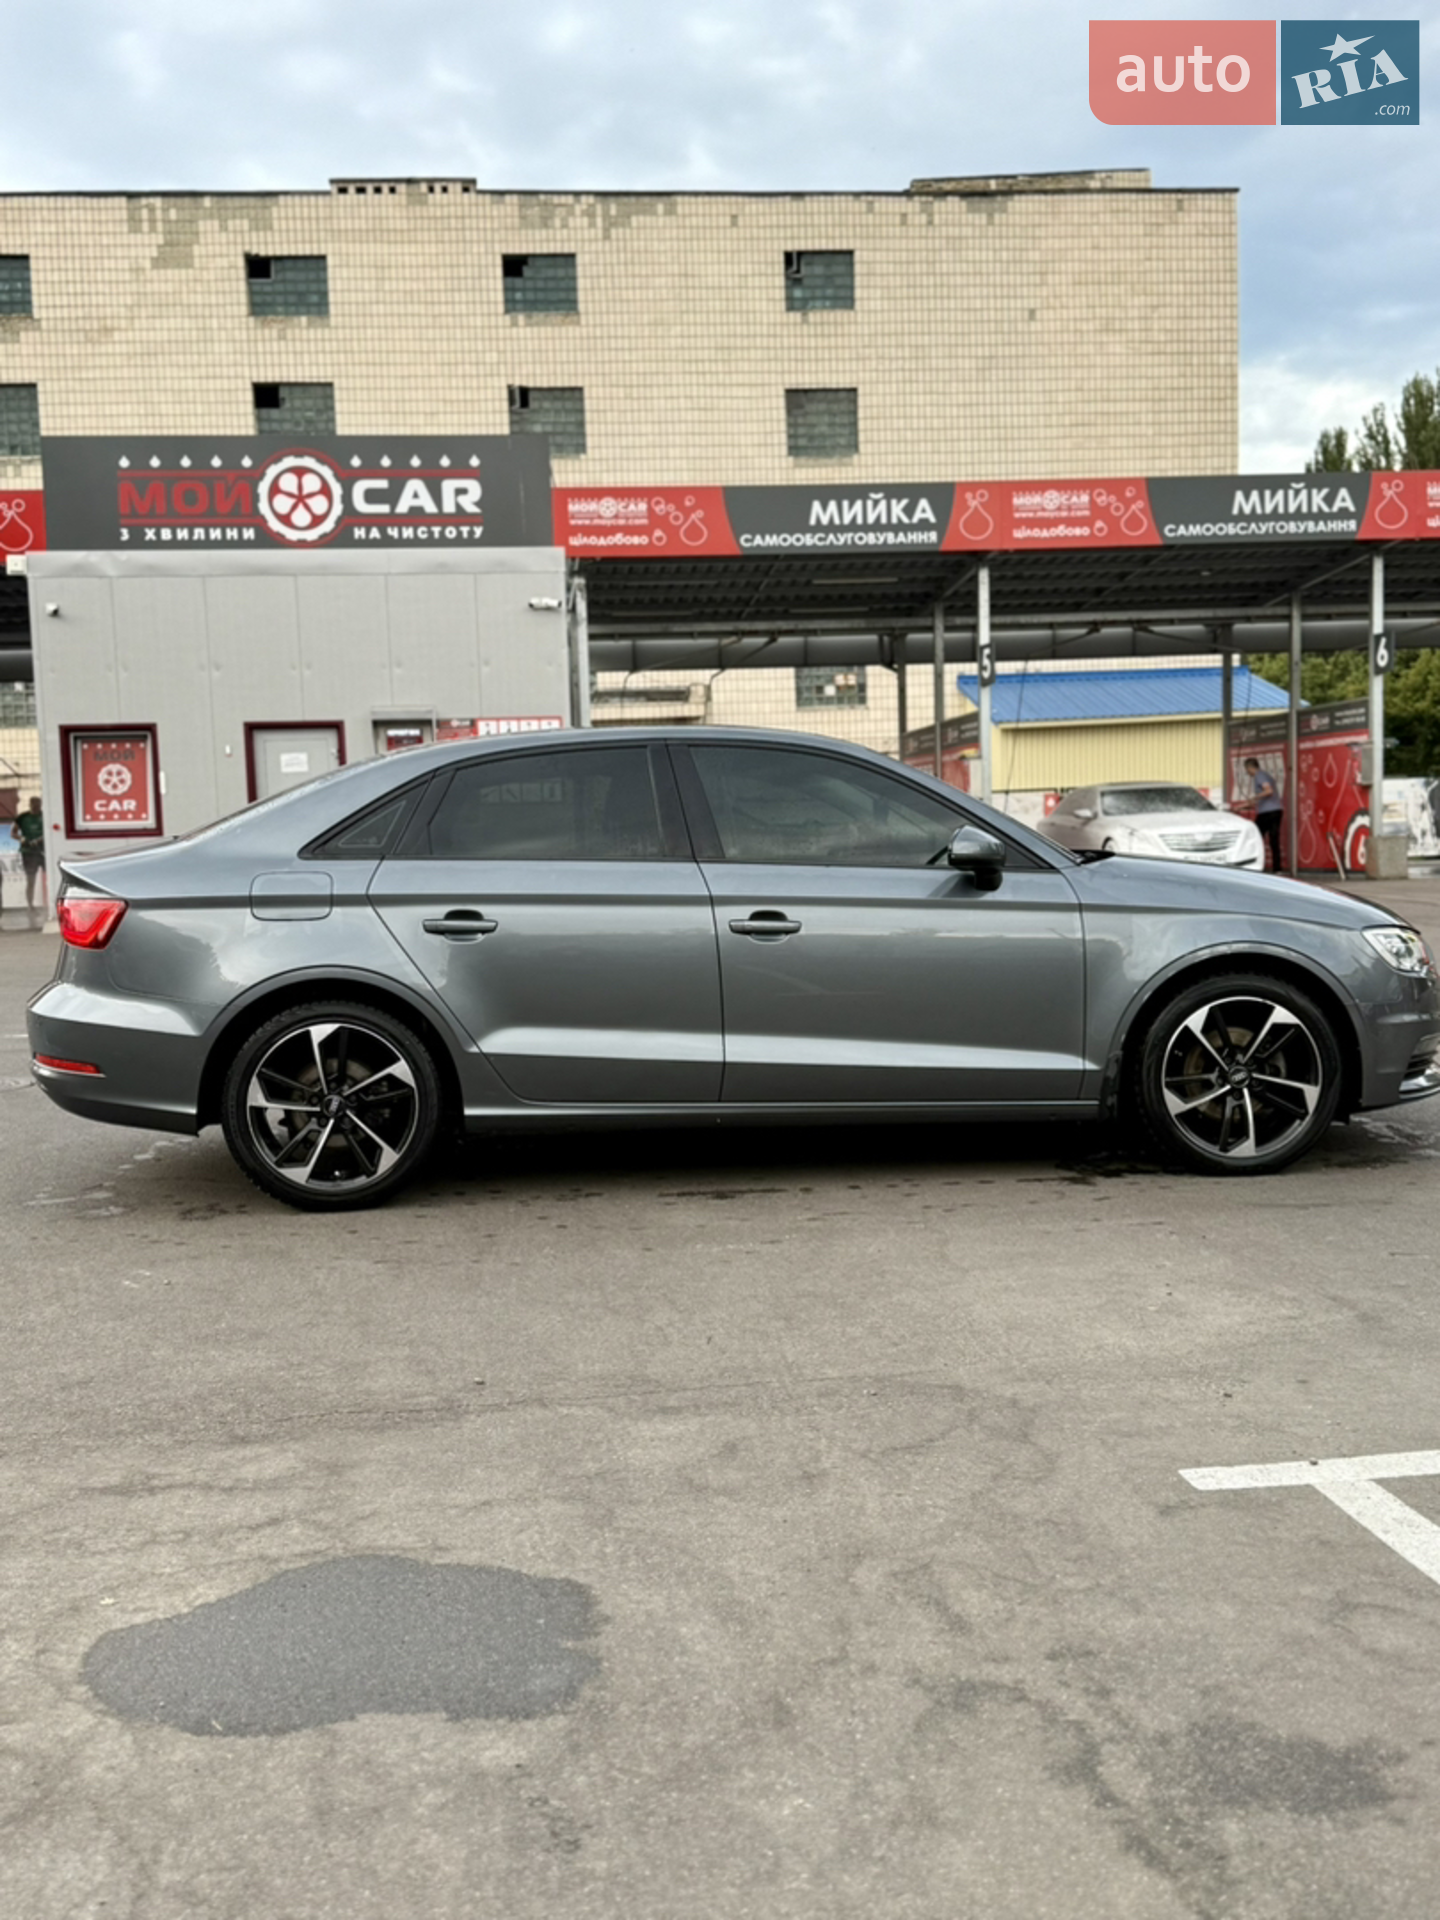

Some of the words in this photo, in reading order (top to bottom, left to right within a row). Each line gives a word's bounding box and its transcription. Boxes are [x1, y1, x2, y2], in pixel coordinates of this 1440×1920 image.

[118, 474, 254, 516] МОЙ
[351, 478, 483, 514] CAR
[1231, 481, 1356, 516] МИЙКА
[808, 492, 937, 526] МИЙКА
[144, 527, 256, 542] ХВИЛИНИ
[353, 525, 382, 540] НА
[386, 525, 485, 540] ЧИСТОТУ
[1012, 523, 1091, 540] цілодобово
[1163, 519, 1357, 538] САМООБСЛУГОВУВАННЯ
[568, 532, 650, 547] цілодобово
[739, 530, 938, 548] САМООБСЛУГОВУВАННЯ
[1376, 635, 1390, 668] 6
[981, 646, 991, 680] 5
[93, 799, 137, 812] CAR
